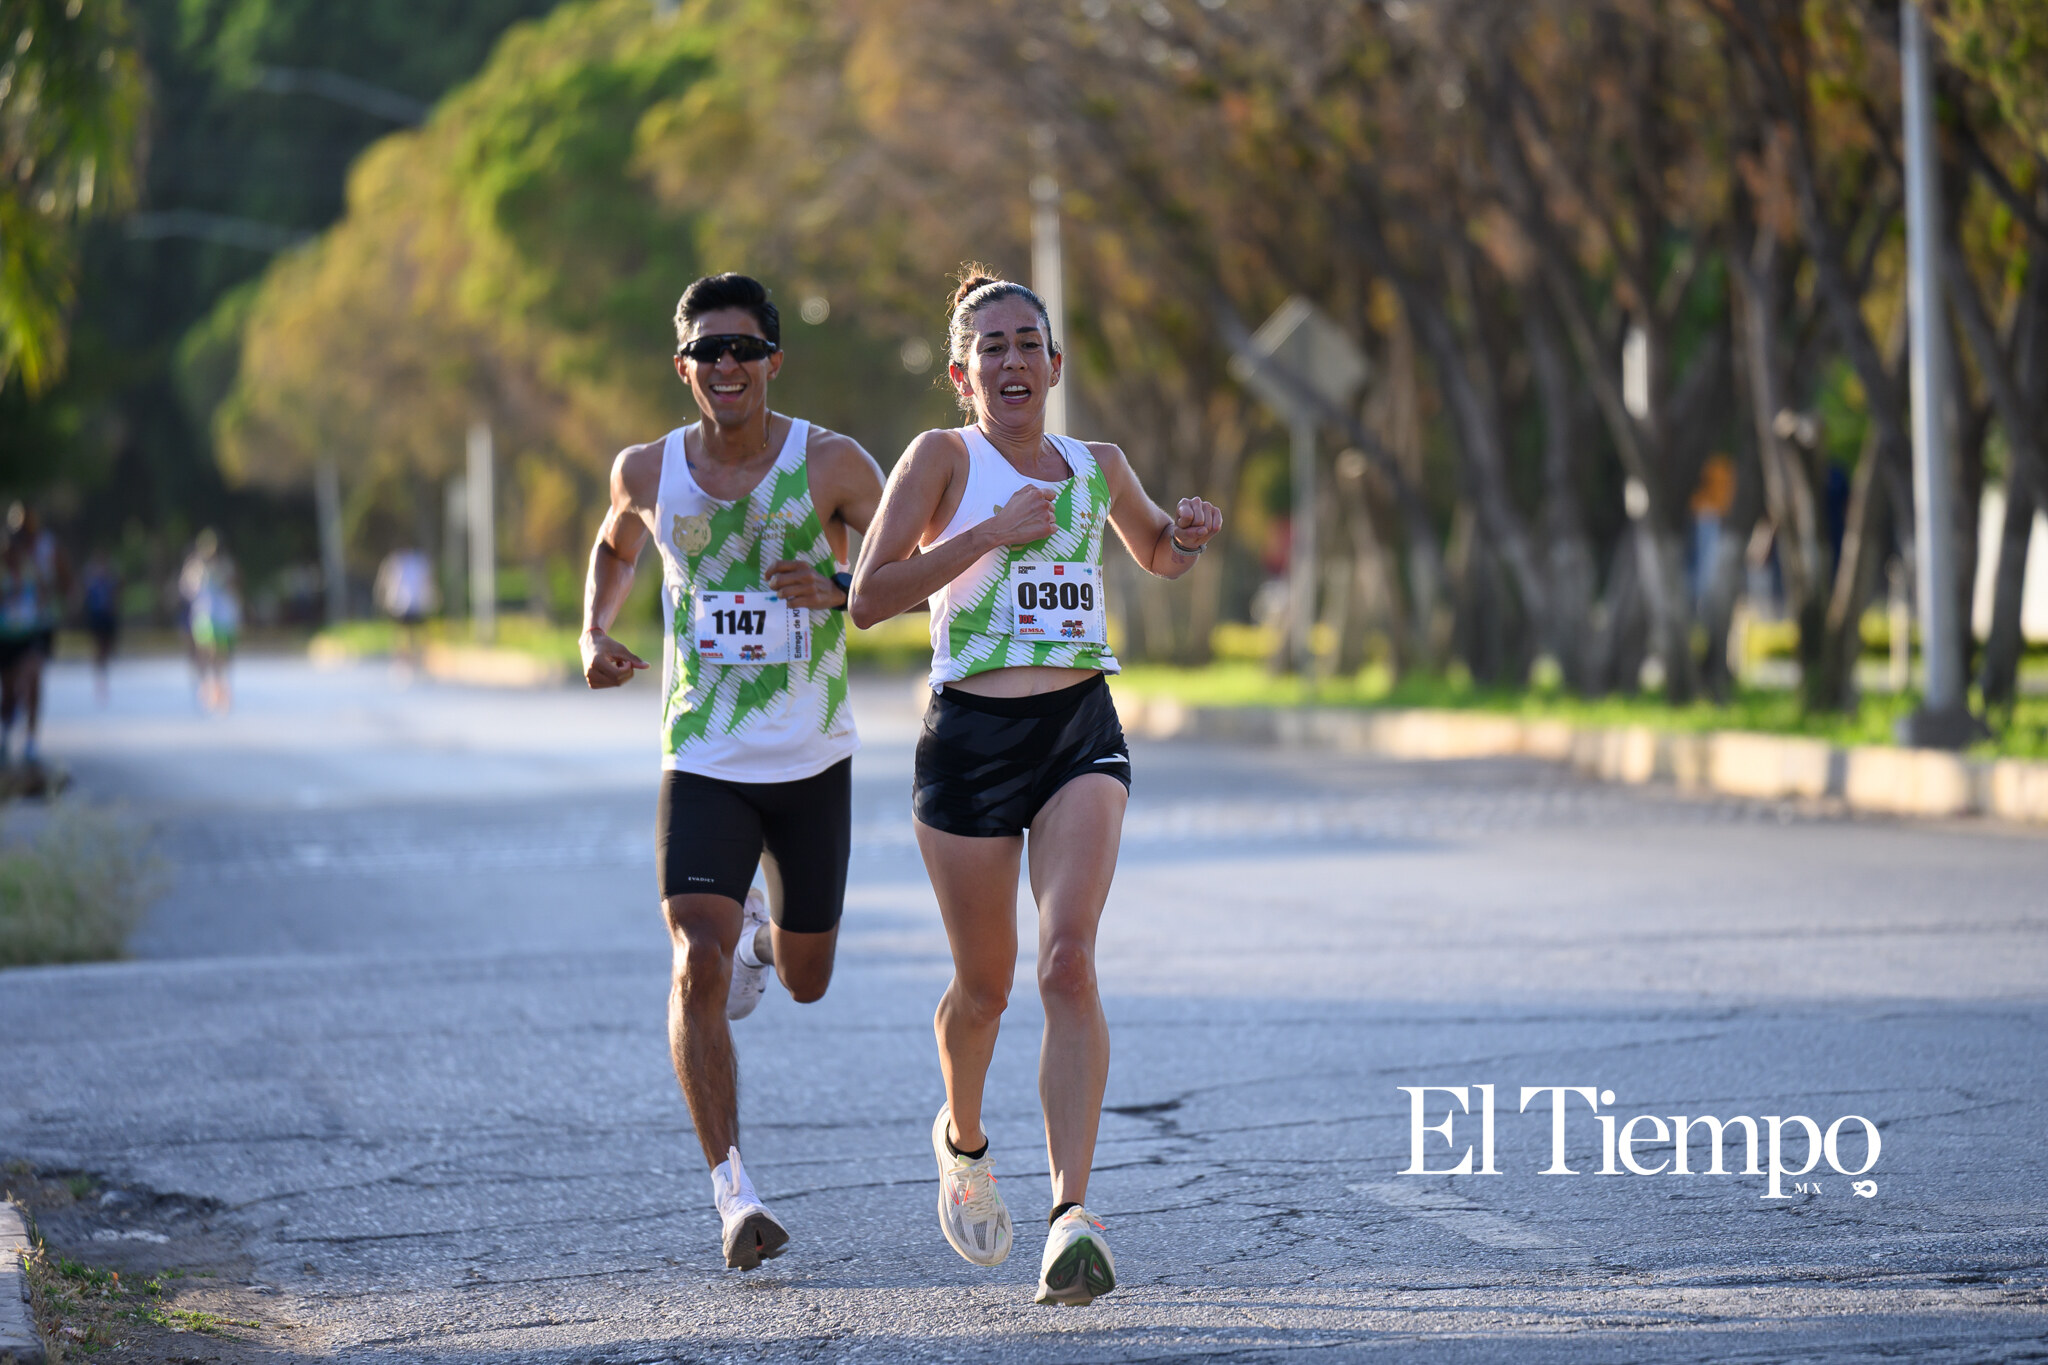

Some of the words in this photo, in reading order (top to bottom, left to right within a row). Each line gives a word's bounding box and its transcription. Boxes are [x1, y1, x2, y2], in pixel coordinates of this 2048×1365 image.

[1017, 582, 1094, 611] 0309
[711, 609, 767, 635] 1147
[793, 618, 801, 629] de
[1018, 614, 1035, 624] 10K
[794, 631, 803, 659] Entrega
